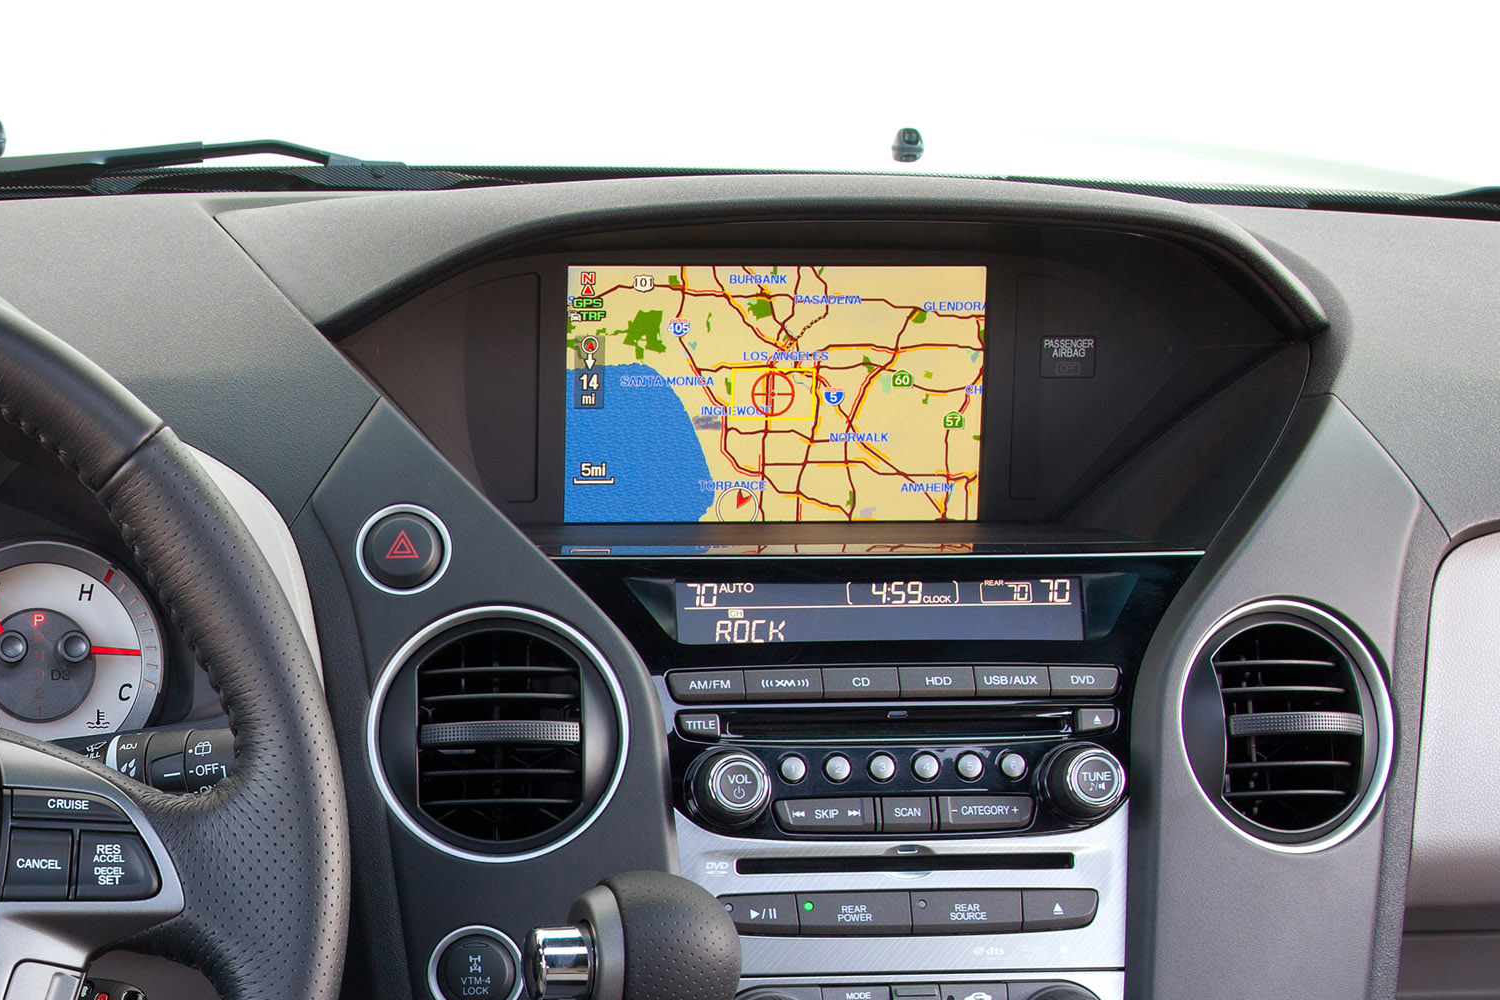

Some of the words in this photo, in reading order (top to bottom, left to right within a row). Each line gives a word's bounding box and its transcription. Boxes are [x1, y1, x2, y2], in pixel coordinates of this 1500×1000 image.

[634, 278, 653, 288] 101
[729, 275, 787, 285] BURBANK
[573, 299, 602, 308] GPS
[795, 295, 861, 304] PASADENA
[581, 312, 605, 321] TRF
[668, 323, 690, 333] 405
[1044, 339, 1094, 348] PASSENGER
[743, 352, 767, 361] LOS
[772, 351, 829, 361] ANGELES
[1052, 348, 1086, 358] AIRBAG
[580, 375, 598, 390] 14
[620, 377, 663, 386] SANTA
[666, 377, 714, 386] MONICA
[894, 375, 910, 386] 60
[582, 393, 595, 405] mi
[829, 392, 838, 401] 5
[945, 416, 961, 427] 57
[829, 433, 889, 442] NORWALK
[581, 463, 607, 476] 5mi
[699, 481, 767, 490] TORRANCE
[900, 483, 954, 492] ANAHEIM
[78, 584, 94, 601] H
[687, 583, 717, 607] 70
[719, 583, 754, 593] AUTO
[871, 581, 923, 604] 4:59
[923, 595, 951, 604] CLOCK
[1007, 585, 1029, 601] 70
[1039, 579, 1070, 603] 70
[34, 614, 44, 626] P
[715, 620, 786, 643] ROCK
[34, 632, 44, 643] R
[51, 669, 71, 681] D3
[984, 675, 1038, 685] USB/AUX
[1070, 675, 1095, 685] DVD
[689, 680, 731, 690] AM/FM
[852, 677, 870, 687] CD
[925, 676, 952, 686] HDD
[118, 684, 132, 701] C
[686, 720, 716, 729] TITLE
[119, 743, 138, 751] ADJ
[835, 764, 842, 773] 2
[879, 763, 886, 771] 3
[967, 762, 974, 770] 5
[727, 774, 752, 784] VOL
[1081, 771, 1112, 781] TUNE
[47, 799, 89, 810] CRUISE
[814, 809, 839, 819] SKIP
[894, 807, 921, 817] SCAN
[961, 806, 1010, 816] CATEGORY
[96, 845, 121, 854] RES
[16, 858, 62, 869] CANCEL
[93, 855, 125, 863] ACCEL
[94, 867, 125, 875] DECEL
[97, 876, 121, 885] SET
[955, 904, 980, 912] REAR
[838, 914, 873, 922] POWER
[950, 912, 987, 920] SOURCE
[461, 976, 491, 985] VTM-4
[462, 986, 489, 995] LOCK
[846, 992, 871, 1000] MODE
